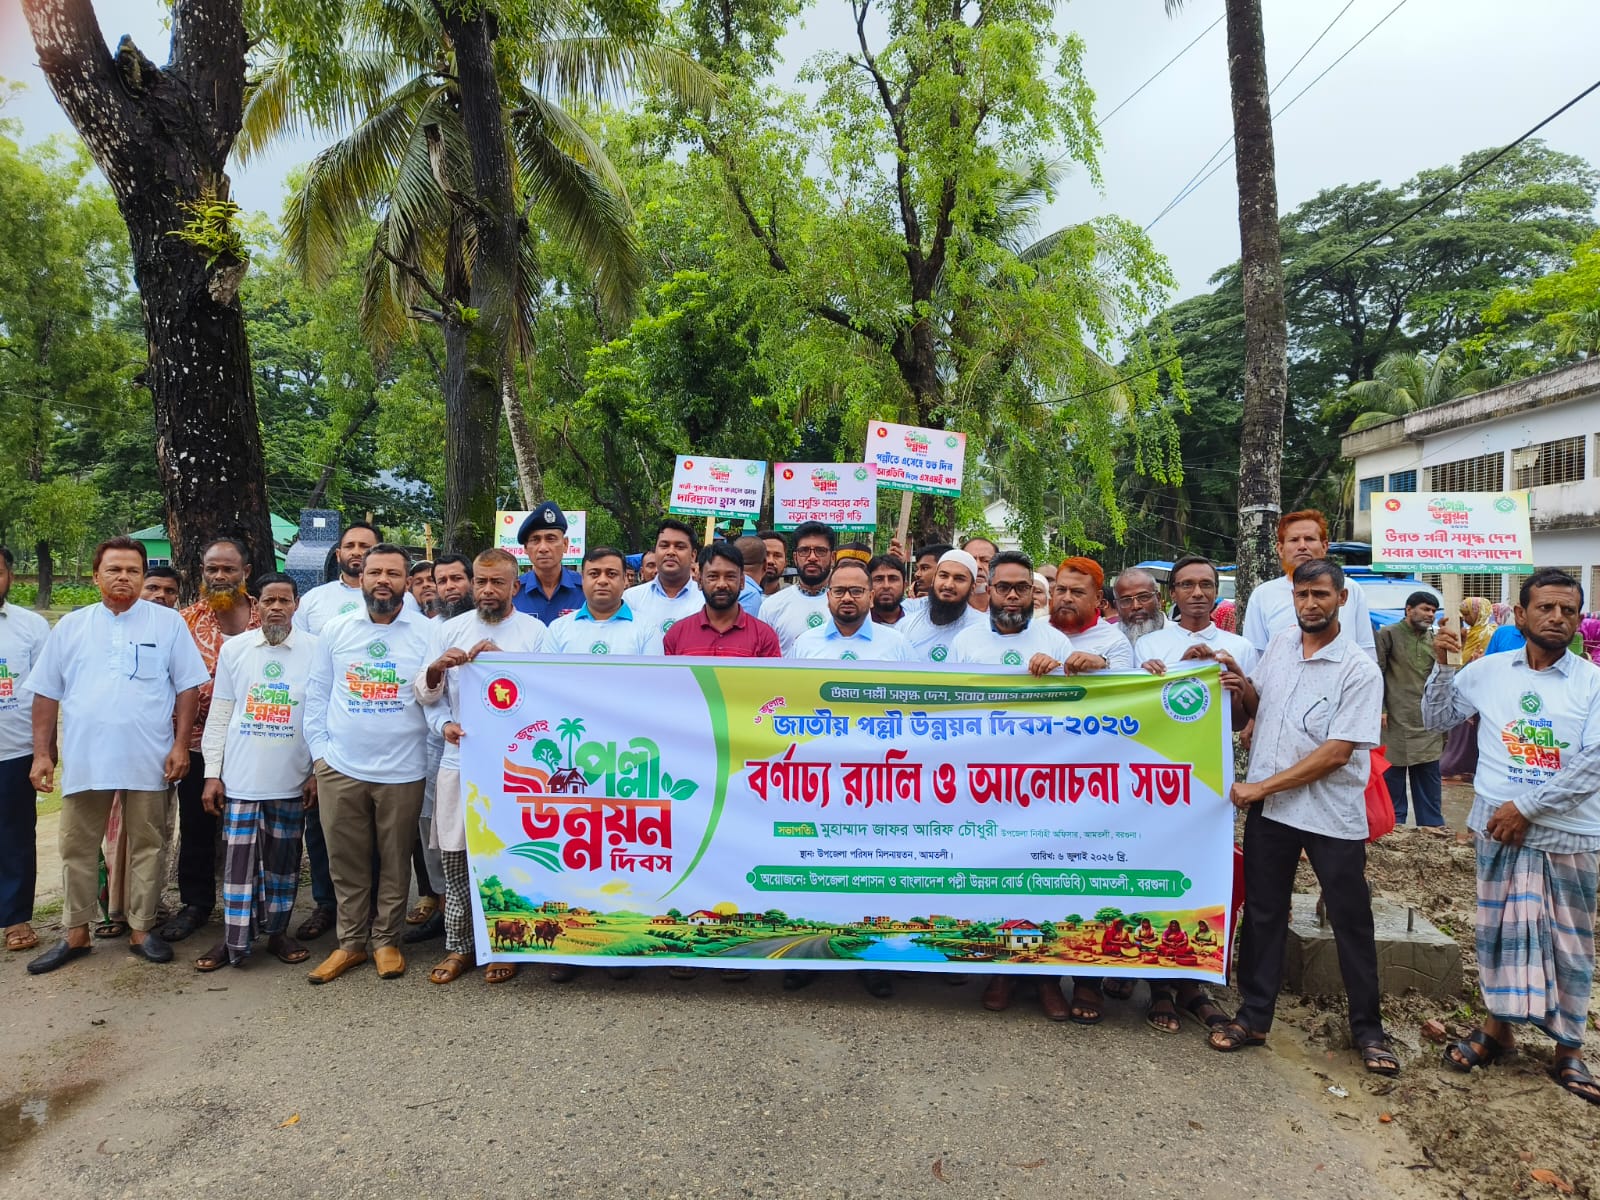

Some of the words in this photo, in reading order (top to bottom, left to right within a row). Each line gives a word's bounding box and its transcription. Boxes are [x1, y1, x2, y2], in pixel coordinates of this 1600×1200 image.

[877, 467, 905, 479] আরডিবি
[1385, 529, 1420, 543] উন্নত
[1423, 529, 1448, 543] পল্লী
[1451, 533, 1485, 546] সমৃদ্ধ
[1488, 533, 1517, 544] দেশ
[1382, 548, 1414, 558] সবার
[1417, 548, 1454, 559] আগে
[1457, 549, 1522, 559] বাংলাদেশ
[863, 687, 887, 700] পল্লী
[759, 696, 786, 714] জুলাই
[773, 709, 850, 736] জাতীয়
[857, 710, 903, 740] পল্লী
[909, 711, 982, 740] উন্নয়ন
[989, 710, 1139, 737] দিবস-২০২৬
[508, 742, 518, 752] ৬
[514, 720, 550, 742] জুলাই
[574, 737, 661, 799] পল্লী
[746, 743, 831, 808] বর্ণাঢ্য
[933, 762, 957, 804] ও
[967, 762, 1120, 808] আলোচনা
[1129, 762, 1192, 806] সভা
[517, 796, 672, 873] উন্নয়ন
[820, 823, 868, 838] মুহাম্মাদ
[872, 824, 909, 837] জাফর
[912, 820, 954, 837] আরিফ
[958, 819, 998, 840] চৌধুরী
[610, 849, 672, 873] দিবস
[817, 848, 847, 859] উপজেলা
[850, 848, 873, 859] পরিষদ
[1058, 853, 1065, 861] ৬
[1067, 851, 1088, 862] জুলাই
[1091, 853, 1114, 862] ২০২৬
[809, 871, 849, 888] উপজেলা
[852, 874, 885, 888] প্রশাসন
[889, 876, 897, 887] ও
[900, 875, 944, 889] বাংলাদেশ
[948, 872, 967, 890] পল্লী
[970, 873, 998, 890] উন্নয়ন
[1001, 873, 1024, 889] বোর্ড
[1027, 873, 1086, 893] (বিআরডিবি)
